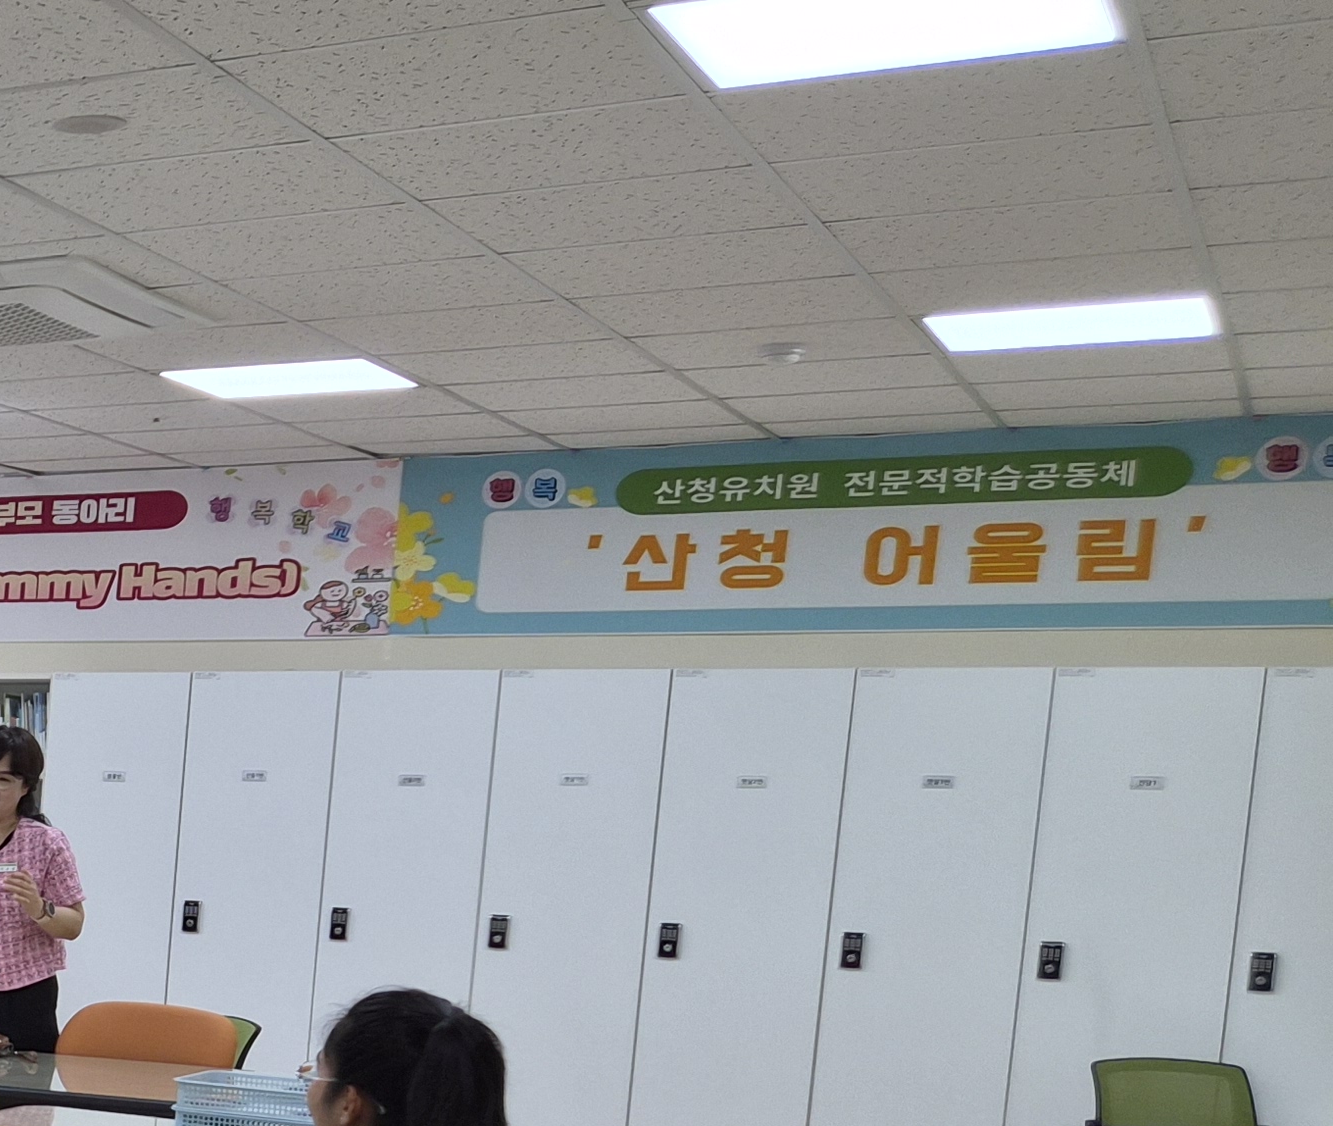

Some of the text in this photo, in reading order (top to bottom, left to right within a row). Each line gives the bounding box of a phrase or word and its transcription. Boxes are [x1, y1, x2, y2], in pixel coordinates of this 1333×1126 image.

[653, 458, 1138, 506] 산청유치원 전문적학습공동체
[50, 497, 136, 525] 동아리
[116, 557, 302, 601] Hands)
